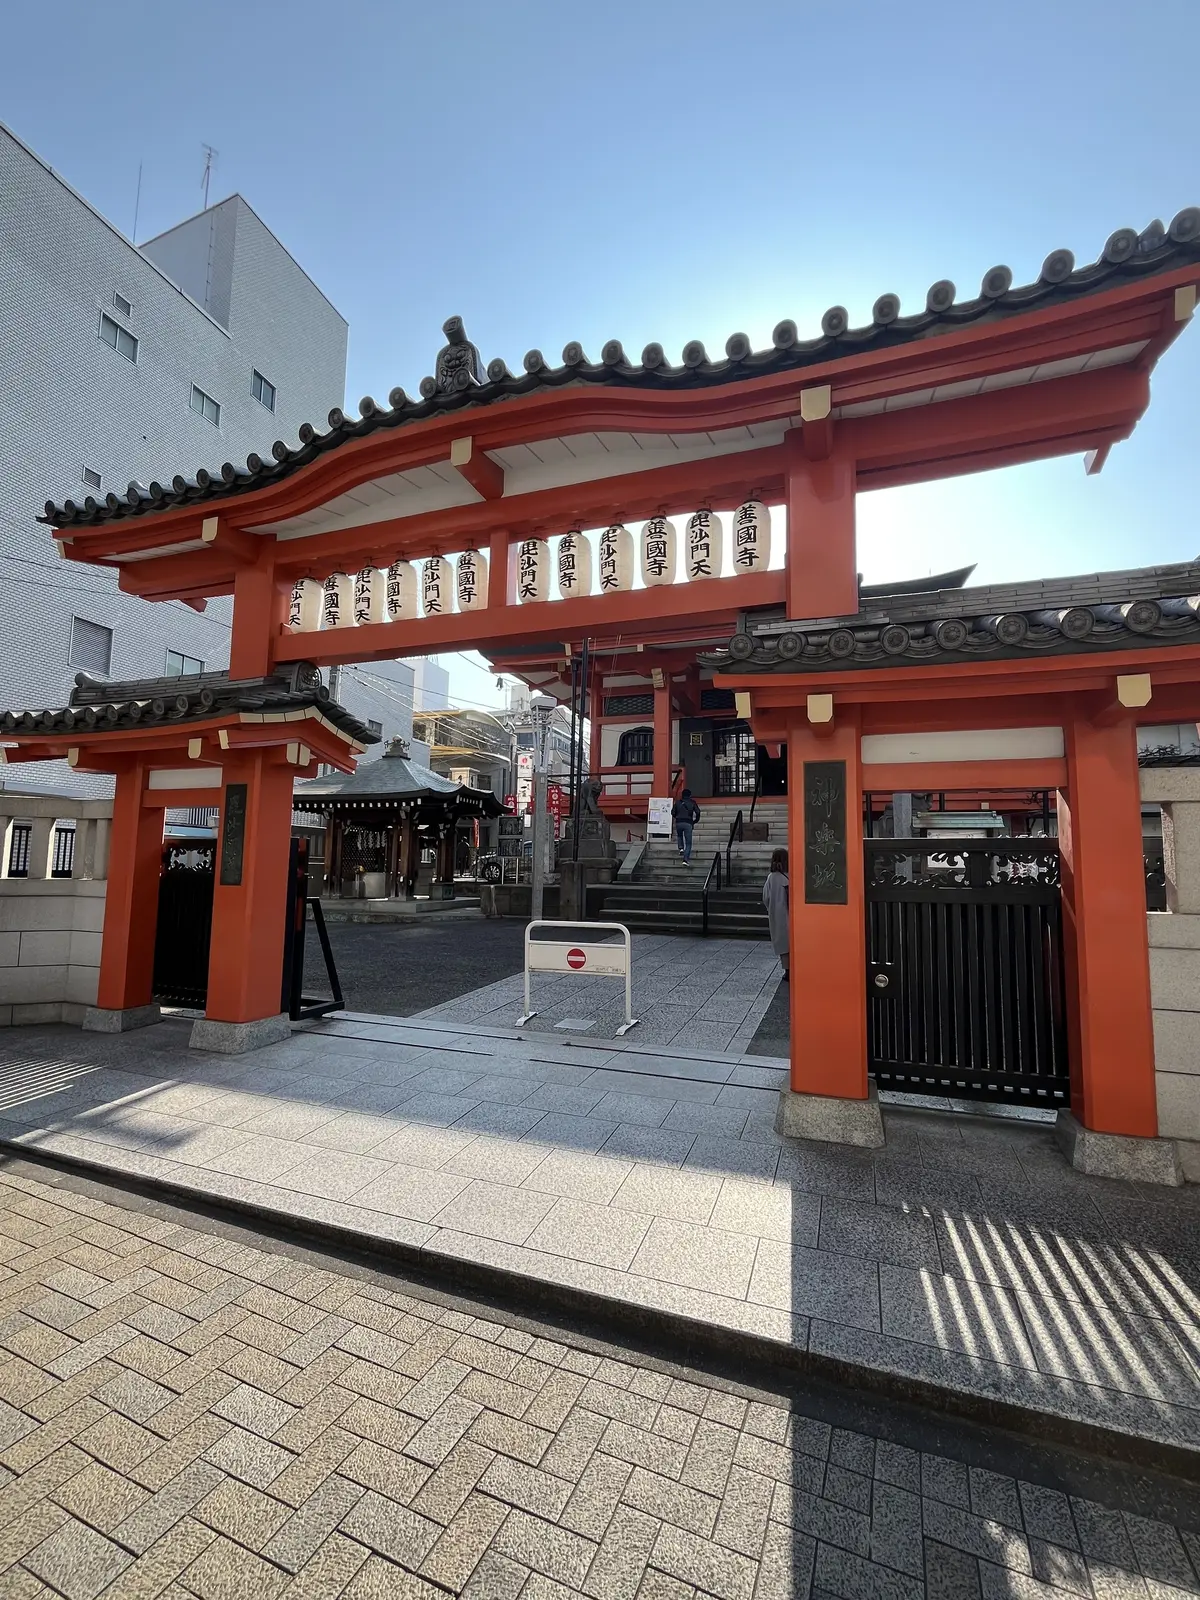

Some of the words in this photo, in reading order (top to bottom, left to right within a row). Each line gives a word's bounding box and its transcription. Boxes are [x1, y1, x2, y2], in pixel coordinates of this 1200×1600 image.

[558, 534, 577, 588] 善國寺
[600, 528, 619, 589] 毘沙門天
[646, 520, 668, 576] 善國寺
[690, 513, 712, 577] 毘沙門天
[736, 504, 759, 567] 善國寺
[355, 569, 372, 622] 毘沙門天
[387, 563, 402, 614] 善國寺
[424, 559, 442, 613] 毘沙門天
[459, 553, 477, 603] 善國寺
[519, 541, 538, 598] 毘沙門天
[324, 575, 340, 625] 善國寺
